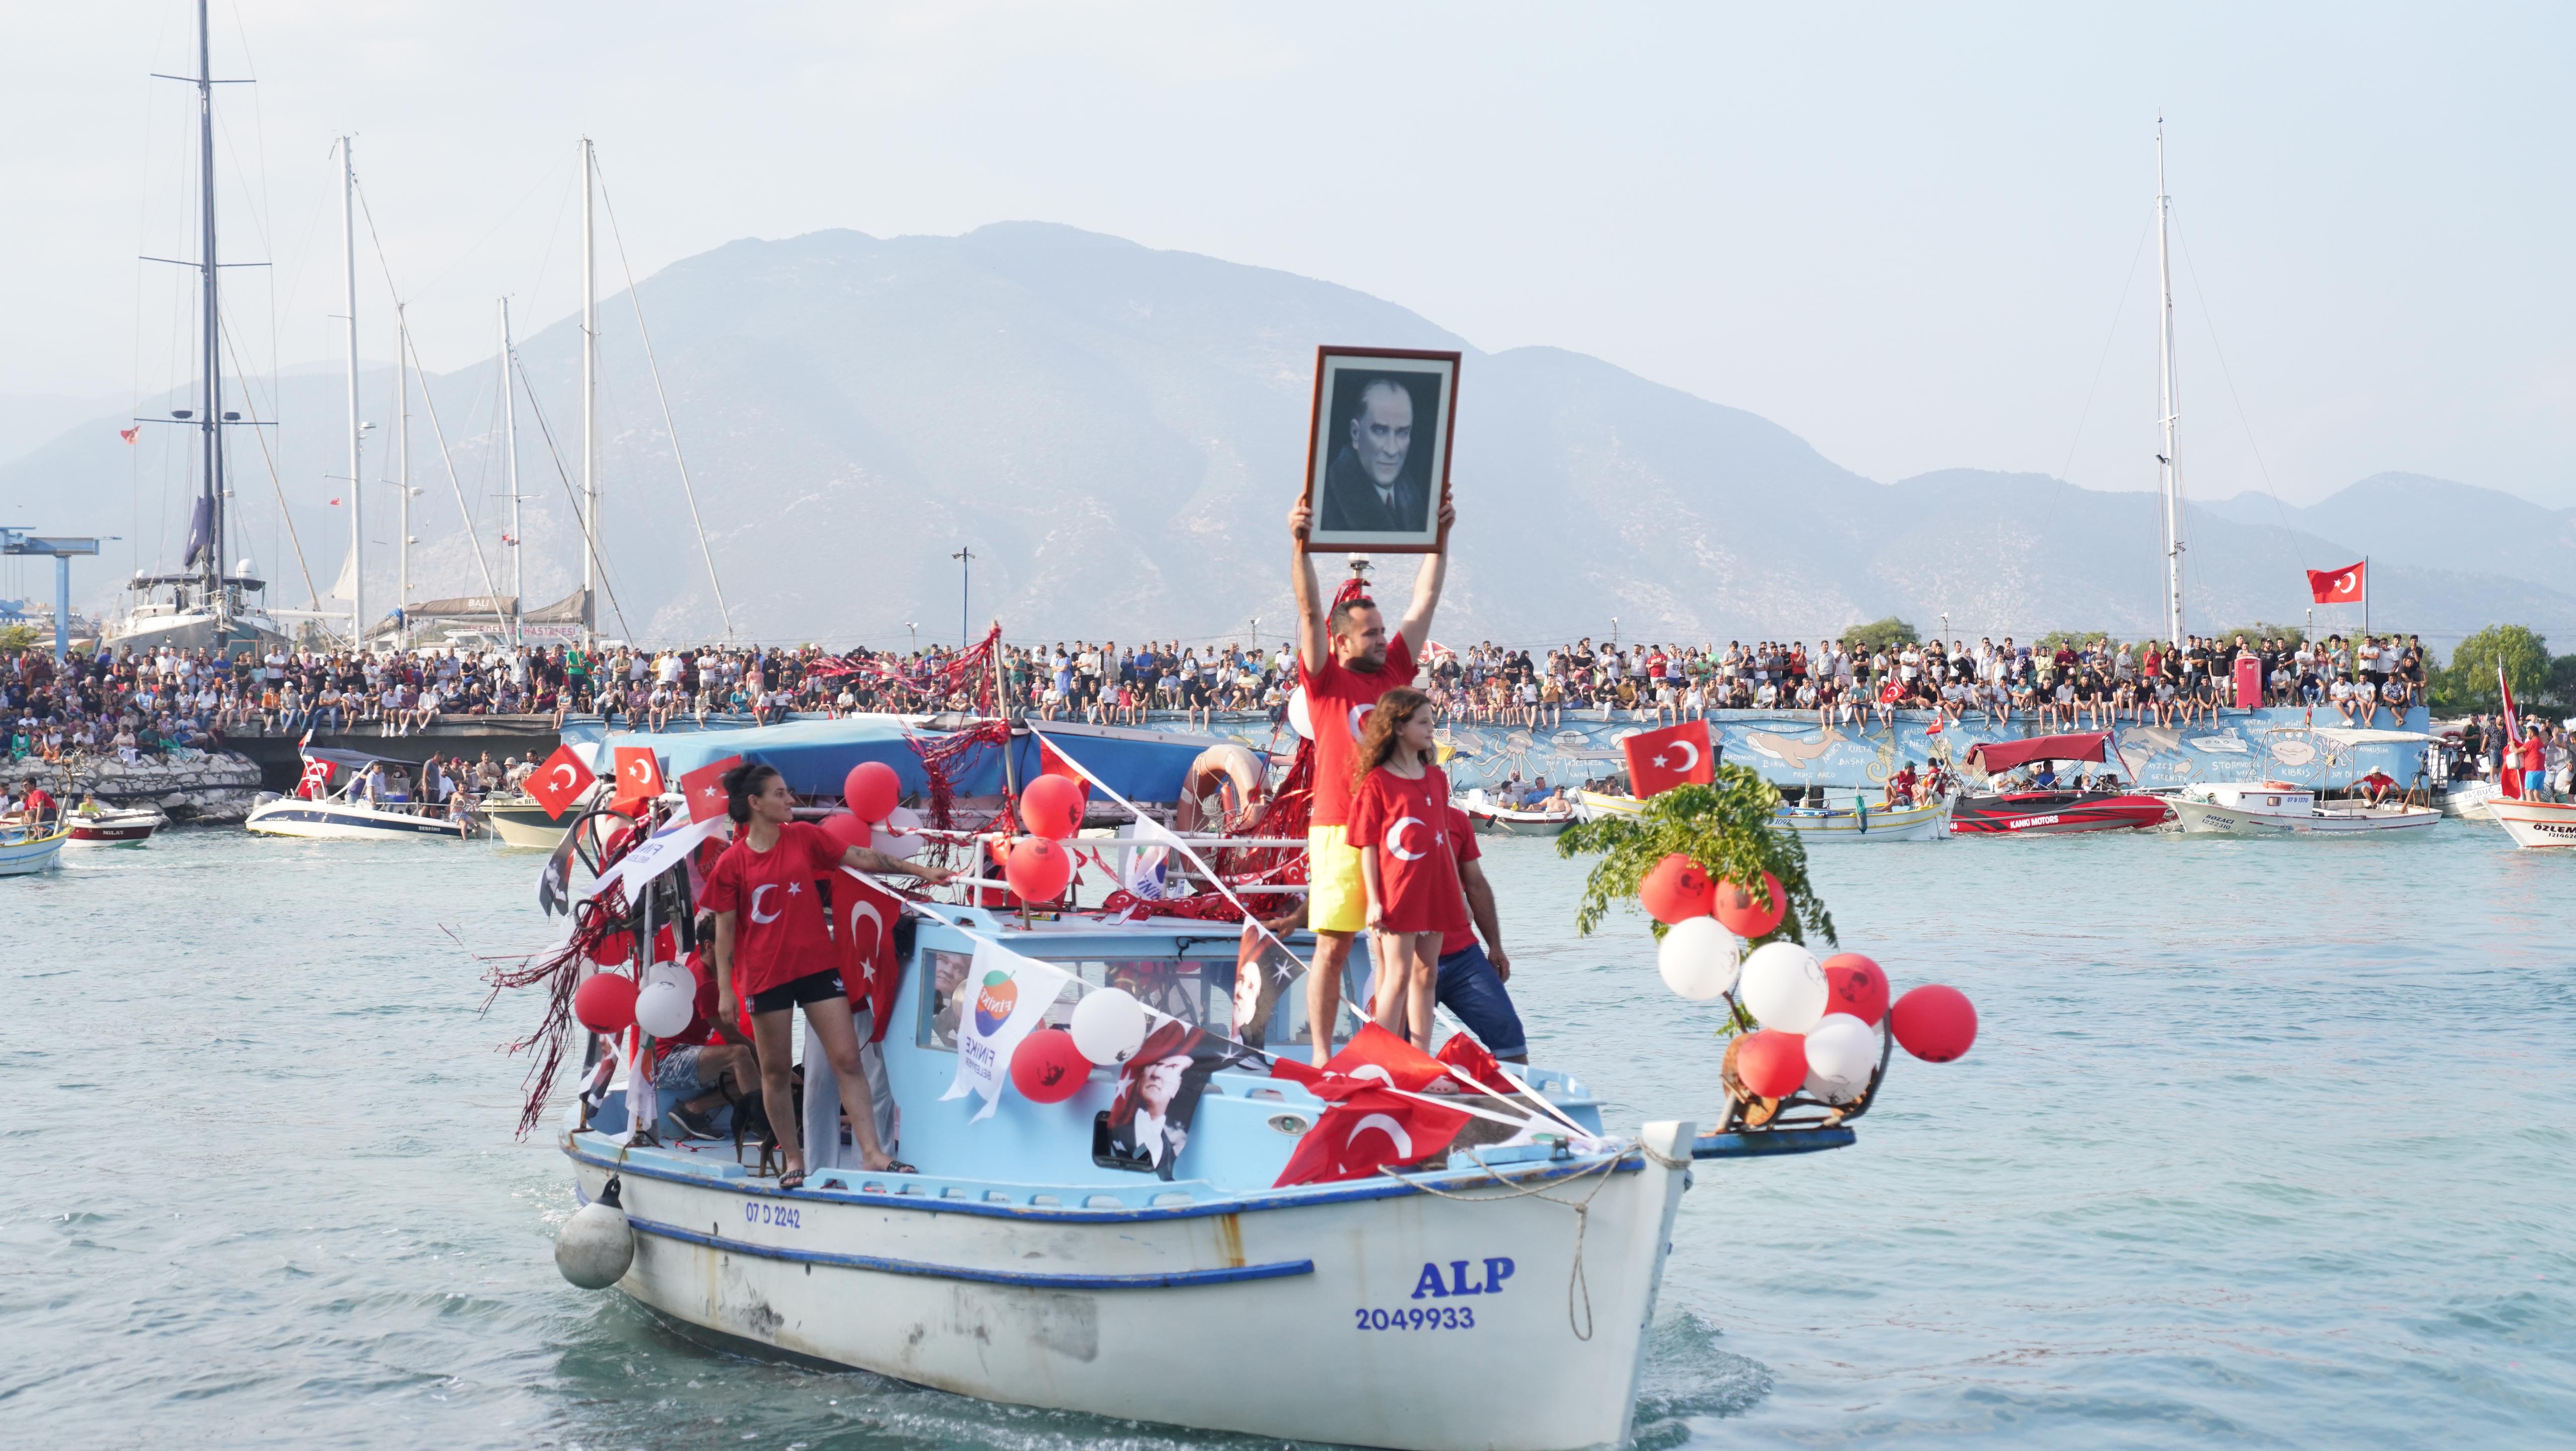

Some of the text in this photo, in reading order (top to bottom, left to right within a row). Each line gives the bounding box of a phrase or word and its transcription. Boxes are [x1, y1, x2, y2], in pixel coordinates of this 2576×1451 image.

[1847, 744, 1873, 754] KULTA
[1724, 753, 1757, 761] ENDYMION
[2151, 774, 2188, 783] SERENITY
[2031, 815, 2059, 826] MOTORS
[2533, 822, 2576, 833] ÖZLEM
[746, 1201, 800, 1229] 07 D 2242
[1411, 1257, 1515, 1300] ALP
[1355, 1306, 1475, 1331] 2049933
